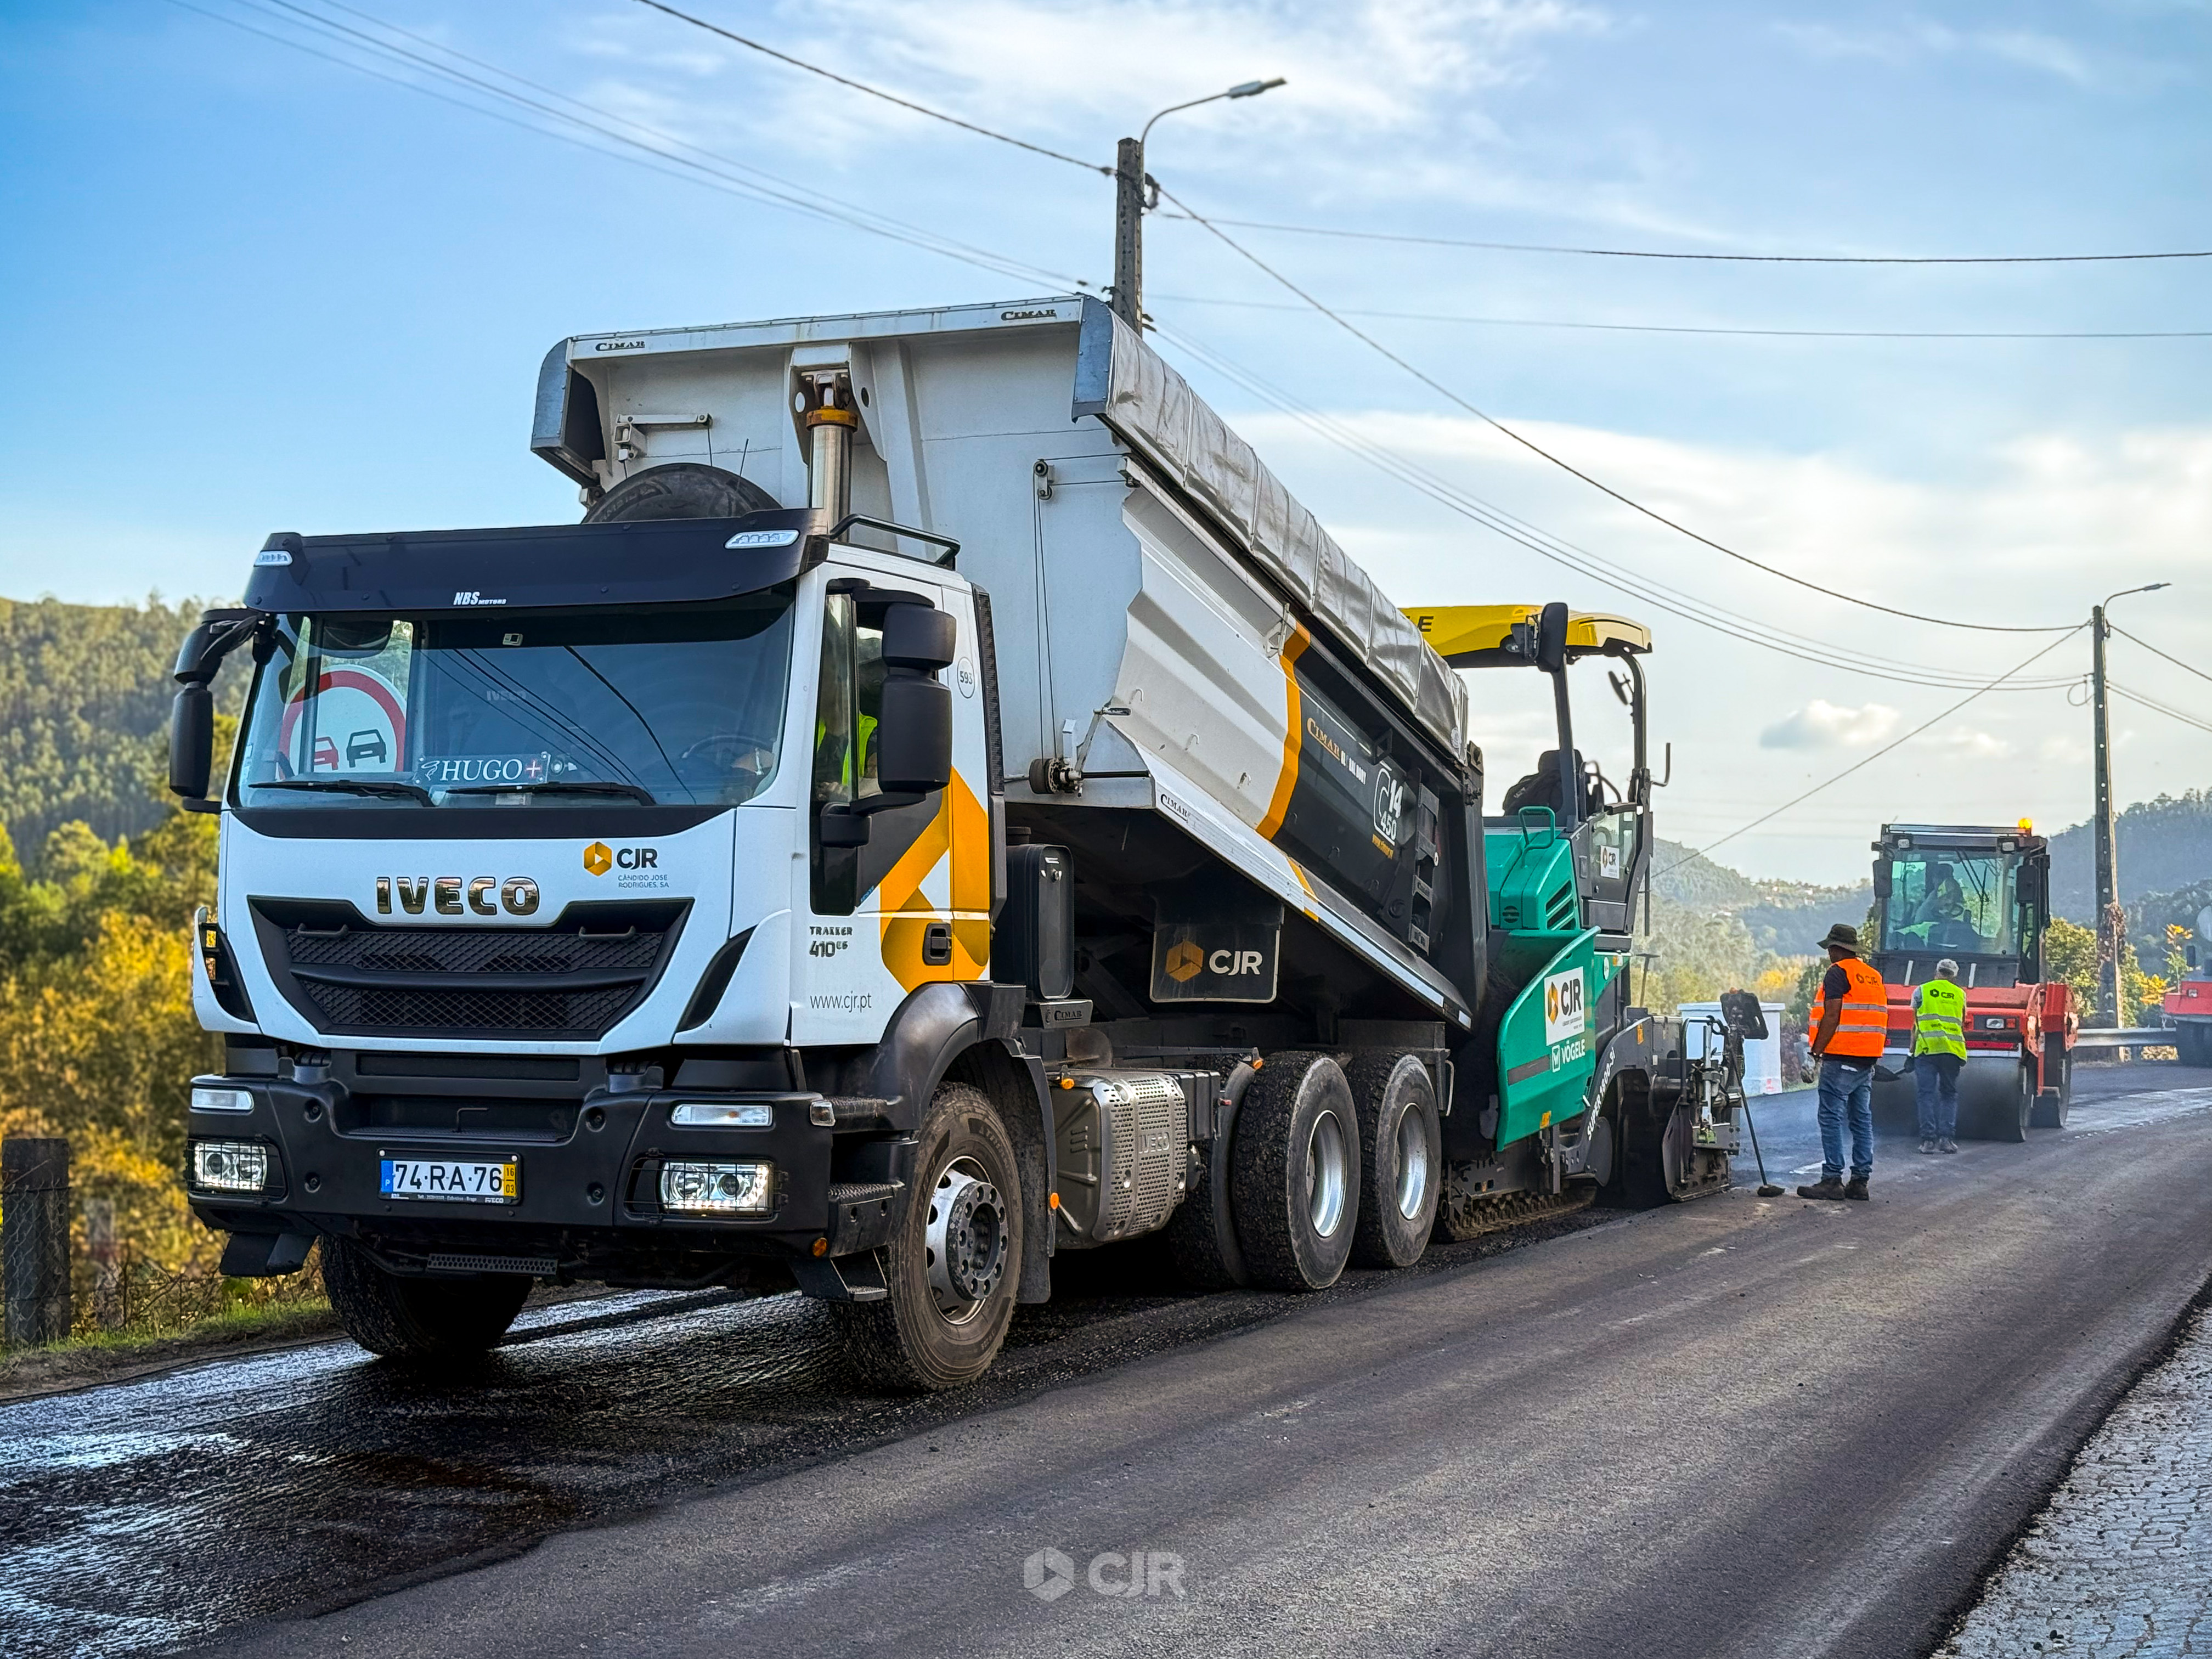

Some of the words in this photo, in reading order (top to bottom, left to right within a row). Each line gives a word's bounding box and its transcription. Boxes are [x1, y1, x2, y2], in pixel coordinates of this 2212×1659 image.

[453, 591, 480, 606] NBS
[960, 670, 973, 685] 593
[439, 759, 522, 781] HUGO
[1389, 779, 1403, 819] 14
[1380, 810, 1397, 840] 450
[617, 848, 658, 870] CJR
[376, 876, 540, 916] IVECO
[809, 940, 836, 958] 410
[1209, 950, 1263, 976] CJR
[810, 990, 872, 1013] www.cjr.pt
[1561, 978, 1582, 1016] CJR
[1561, 1039, 1585, 1064] VÖGELE
[1587, 1094, 1602, 1142] SUPER
[1139, 1131, 1170, 1154] IVECO
[506, 1167, 514, 1177] 16
[506, 1184, 514, 1193] 03
